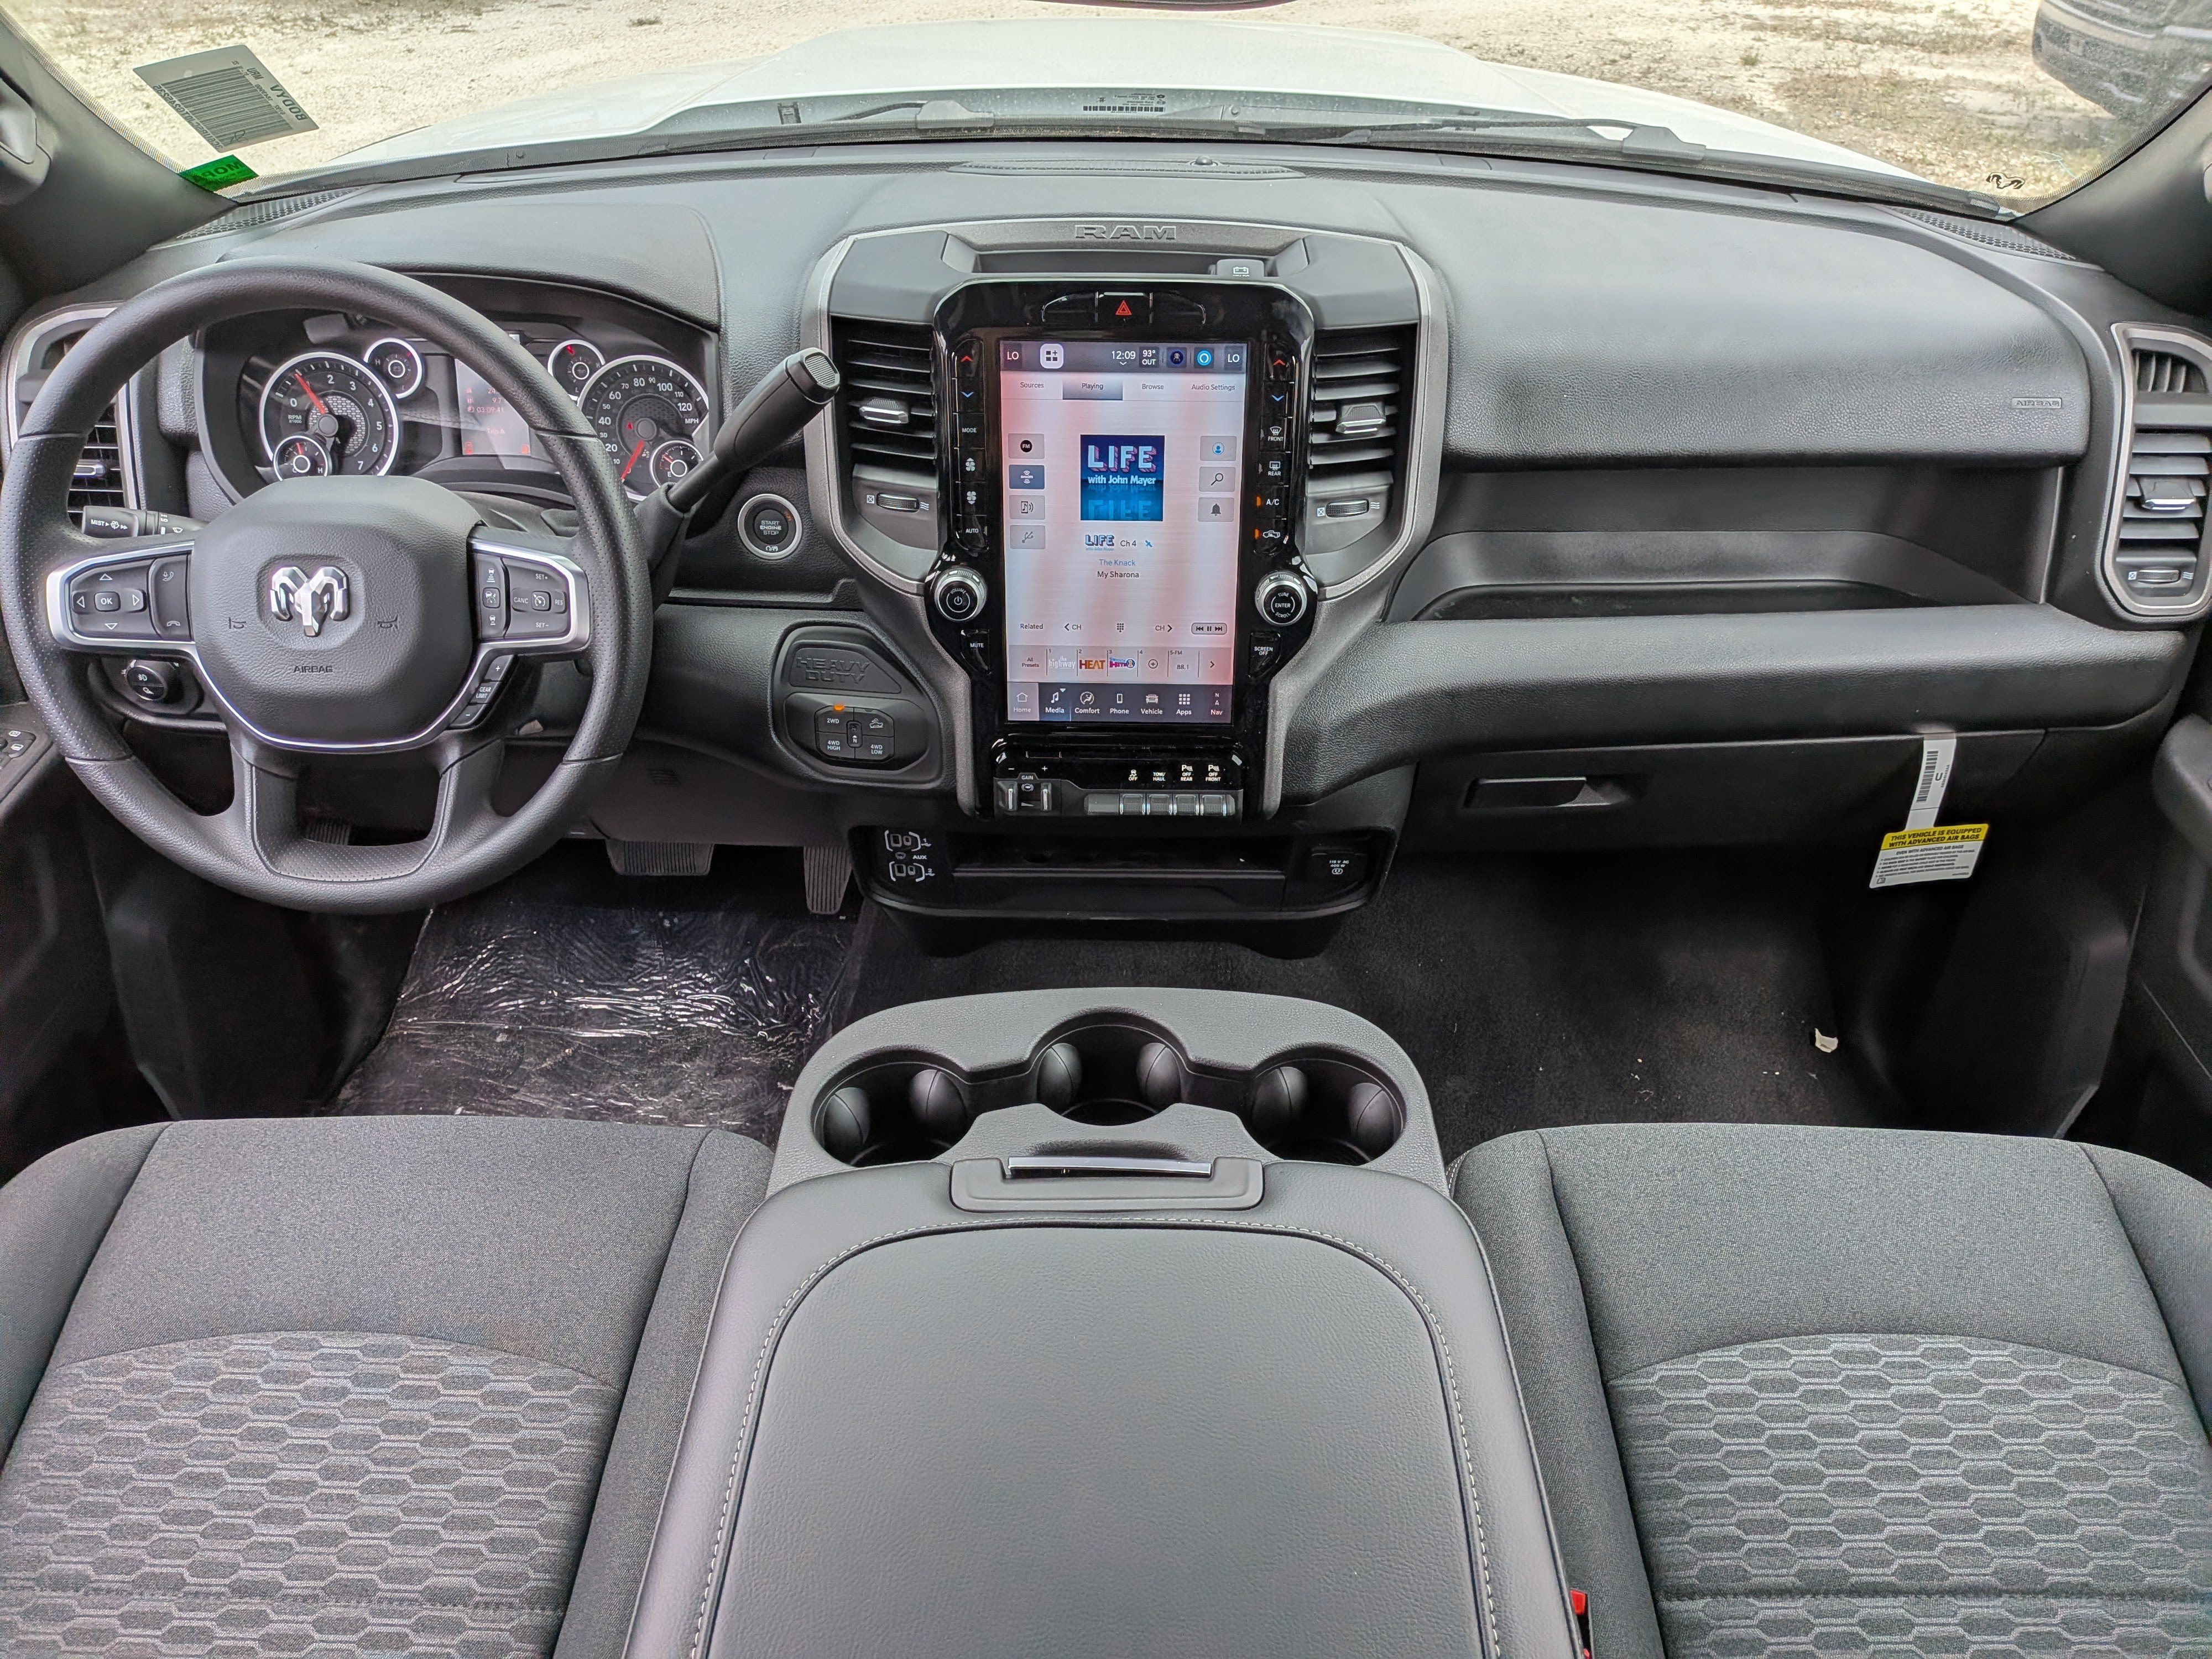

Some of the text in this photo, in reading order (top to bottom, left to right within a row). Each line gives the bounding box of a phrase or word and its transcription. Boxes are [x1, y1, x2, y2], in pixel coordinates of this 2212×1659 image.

[1074, 225, 1177, 240] RAM
[1007, 351, 1019, 360] LO
[1112, 351, 1136, 359] 12:09
[1228, 354, 1240, 363] LO
[327, 374, 335, 384] 2
[633, 378, 645, 387] 80
[349, 382, 357, 390] 3
[657, 383, 673, 392] 100
[609, 392, 622, 400] 60
[290, 398, 298, 407] 0
[368, 399, 374, 408] 4
[677, 403, 692, 411] 120
[598, 417, 611, 425] 40
[376, 422, 383, 430] 5
[372, 444, 378, 452] 6
[605, 444, 618, 452] 20
[1088, 445, 1157, 472] LIFE
[358, 461, 364, 470] 7
[1088, 475, 1156, 486] with John Mayer
[1085, 535, 1115, 546] LIFE
[100, 597, 113, 606] OK
[796, 657, 871, 672] HEAVY
[1048, 659, 1076, 669] highway
[1079, 659, 1105, 670] HEAT
[293, 665, 333, 674] AIRBAG
[806, 670, 865, 684] DUTY
[1935, 773, 1943, 781] U
[1908, 837, 1945, 845] ADVANCED
